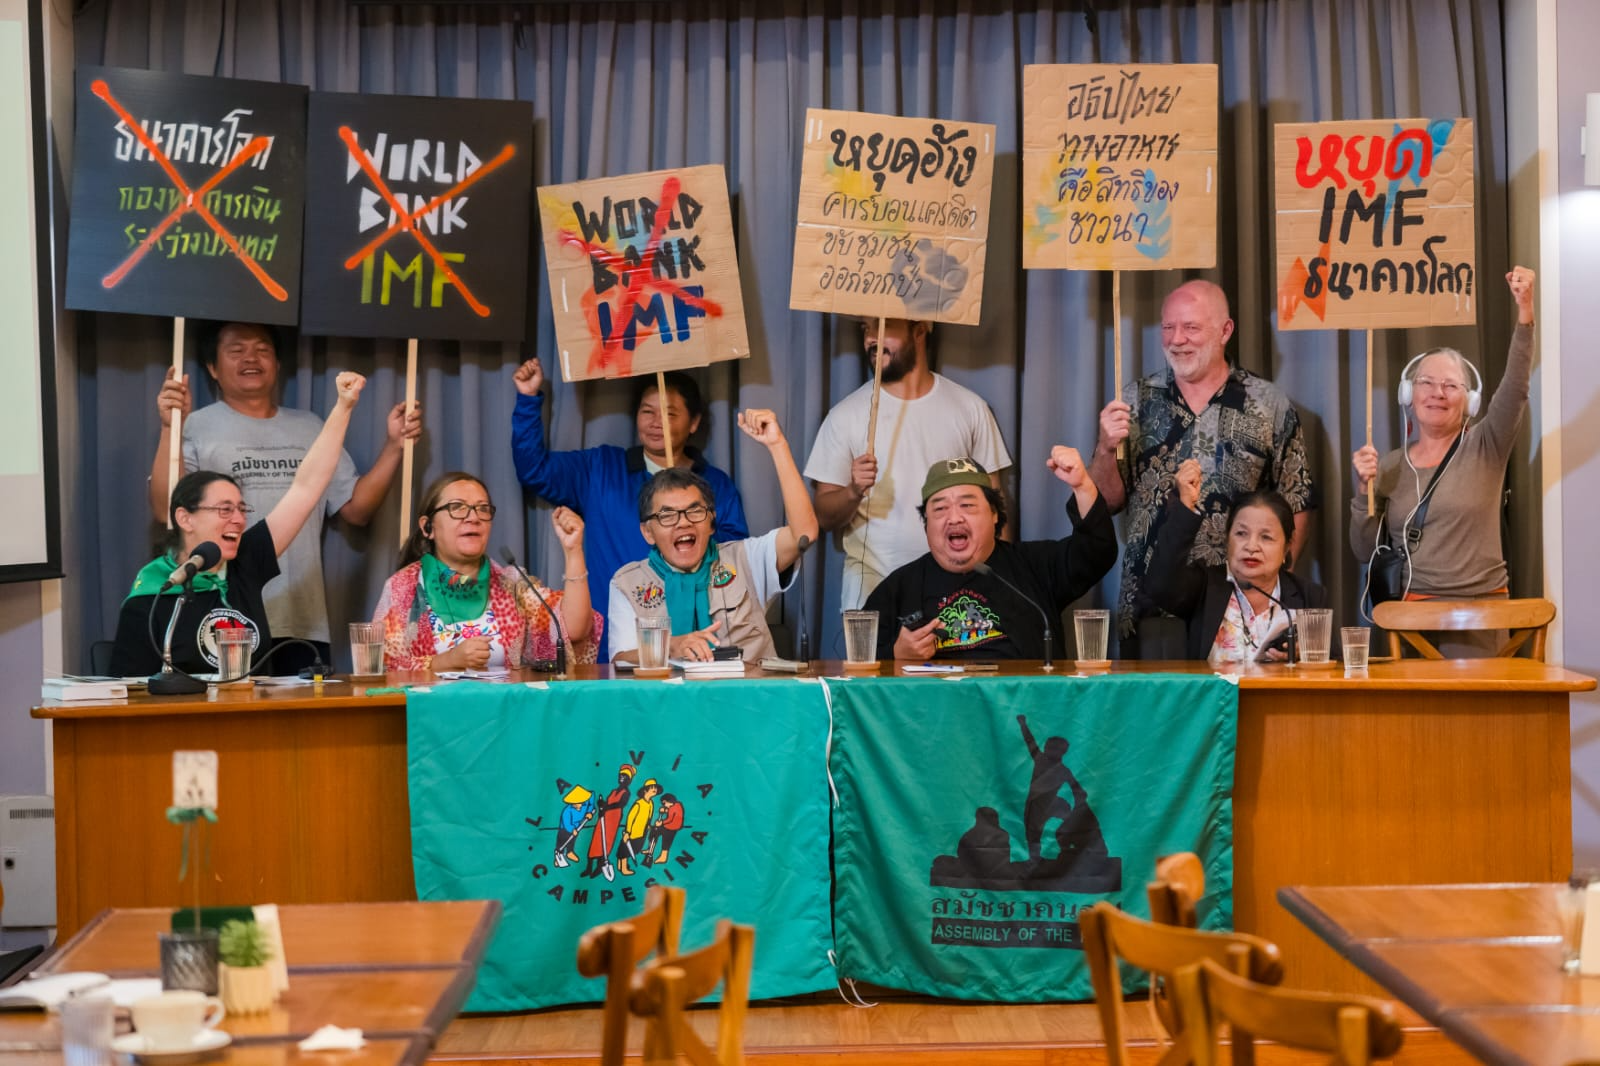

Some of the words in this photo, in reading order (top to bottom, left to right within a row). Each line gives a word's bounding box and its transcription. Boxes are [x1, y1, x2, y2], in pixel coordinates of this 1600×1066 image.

[346, 131, 483, 185] WORLD
[830, 123, 978, 193] หยุดอ้าง
[1057, 132, 1181, 164] ทางอาหาร
[1295, 128, 1434, 199] หยุด
[118, 184, 282, 225] กองทการเงิน
[358, 186, 470, 236] BANK
[572, 192, 704, 244] WORLD
[822, 191, 978, 230] คาร์บอนเครดิต
[1068, 211, 1149, 245] ชาวนา
[1318, 186, 1428, 248] IMF
[361, 249, 467, 308] IMF
[590, 234, 706, 295] BANK
[1303, 235, 1474, 301] ธนาคารโลก
[598, 285, 706, 352] IMF
[231, 456, 302, 472] สมัชชาคน
[931, 891, 1122, 920] สมัชชาคน
[934, 924, 1011, 942] ASSEMBLY
[1018, 927, 1038, 941] OF
[1045, 928, 1073, 942] THE
